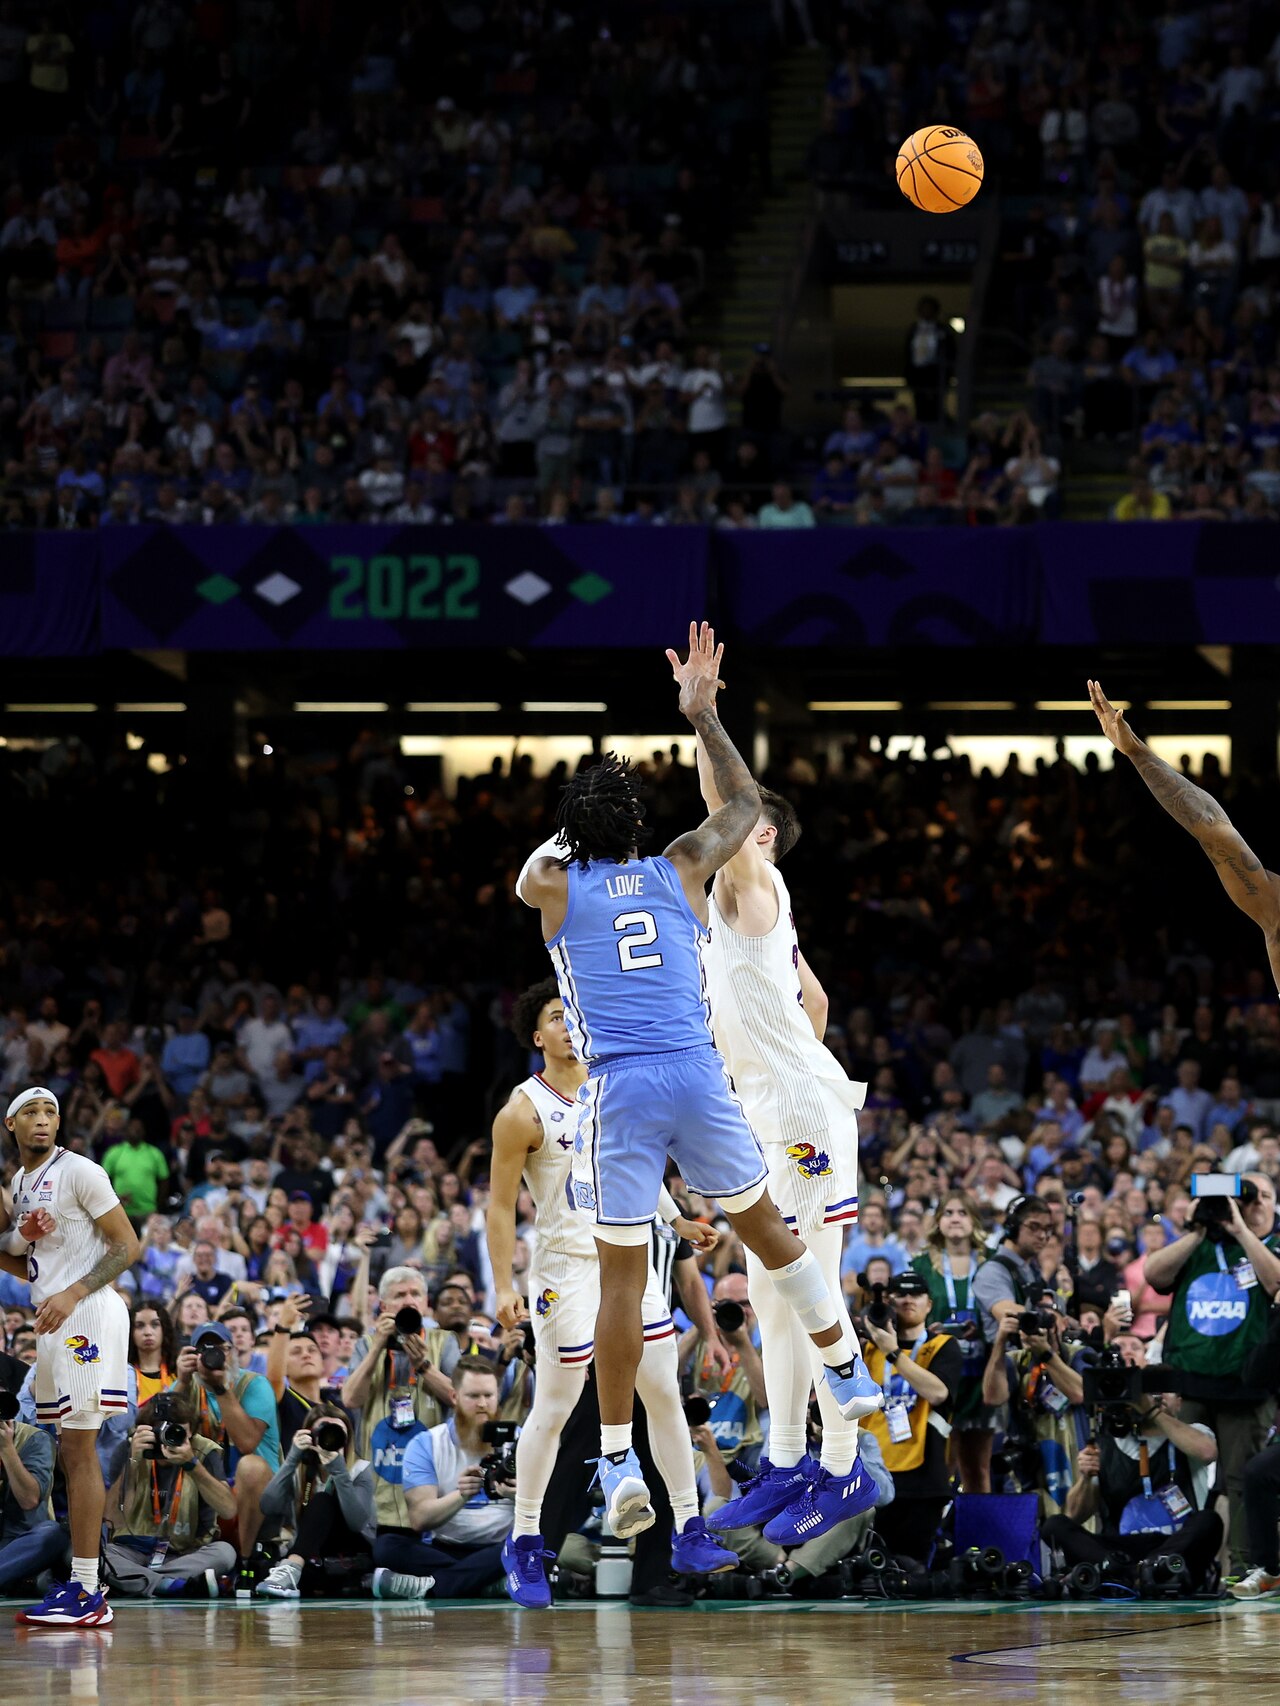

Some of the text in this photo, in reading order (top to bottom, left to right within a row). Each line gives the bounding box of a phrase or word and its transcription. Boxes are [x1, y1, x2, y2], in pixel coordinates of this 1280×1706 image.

[329, 554, 480, 620] 2022
[605, 874, 645, 899] LOVE
[612, 909, 664, 972] 2
[1189, 1300, 1247, 1320] NCAA
